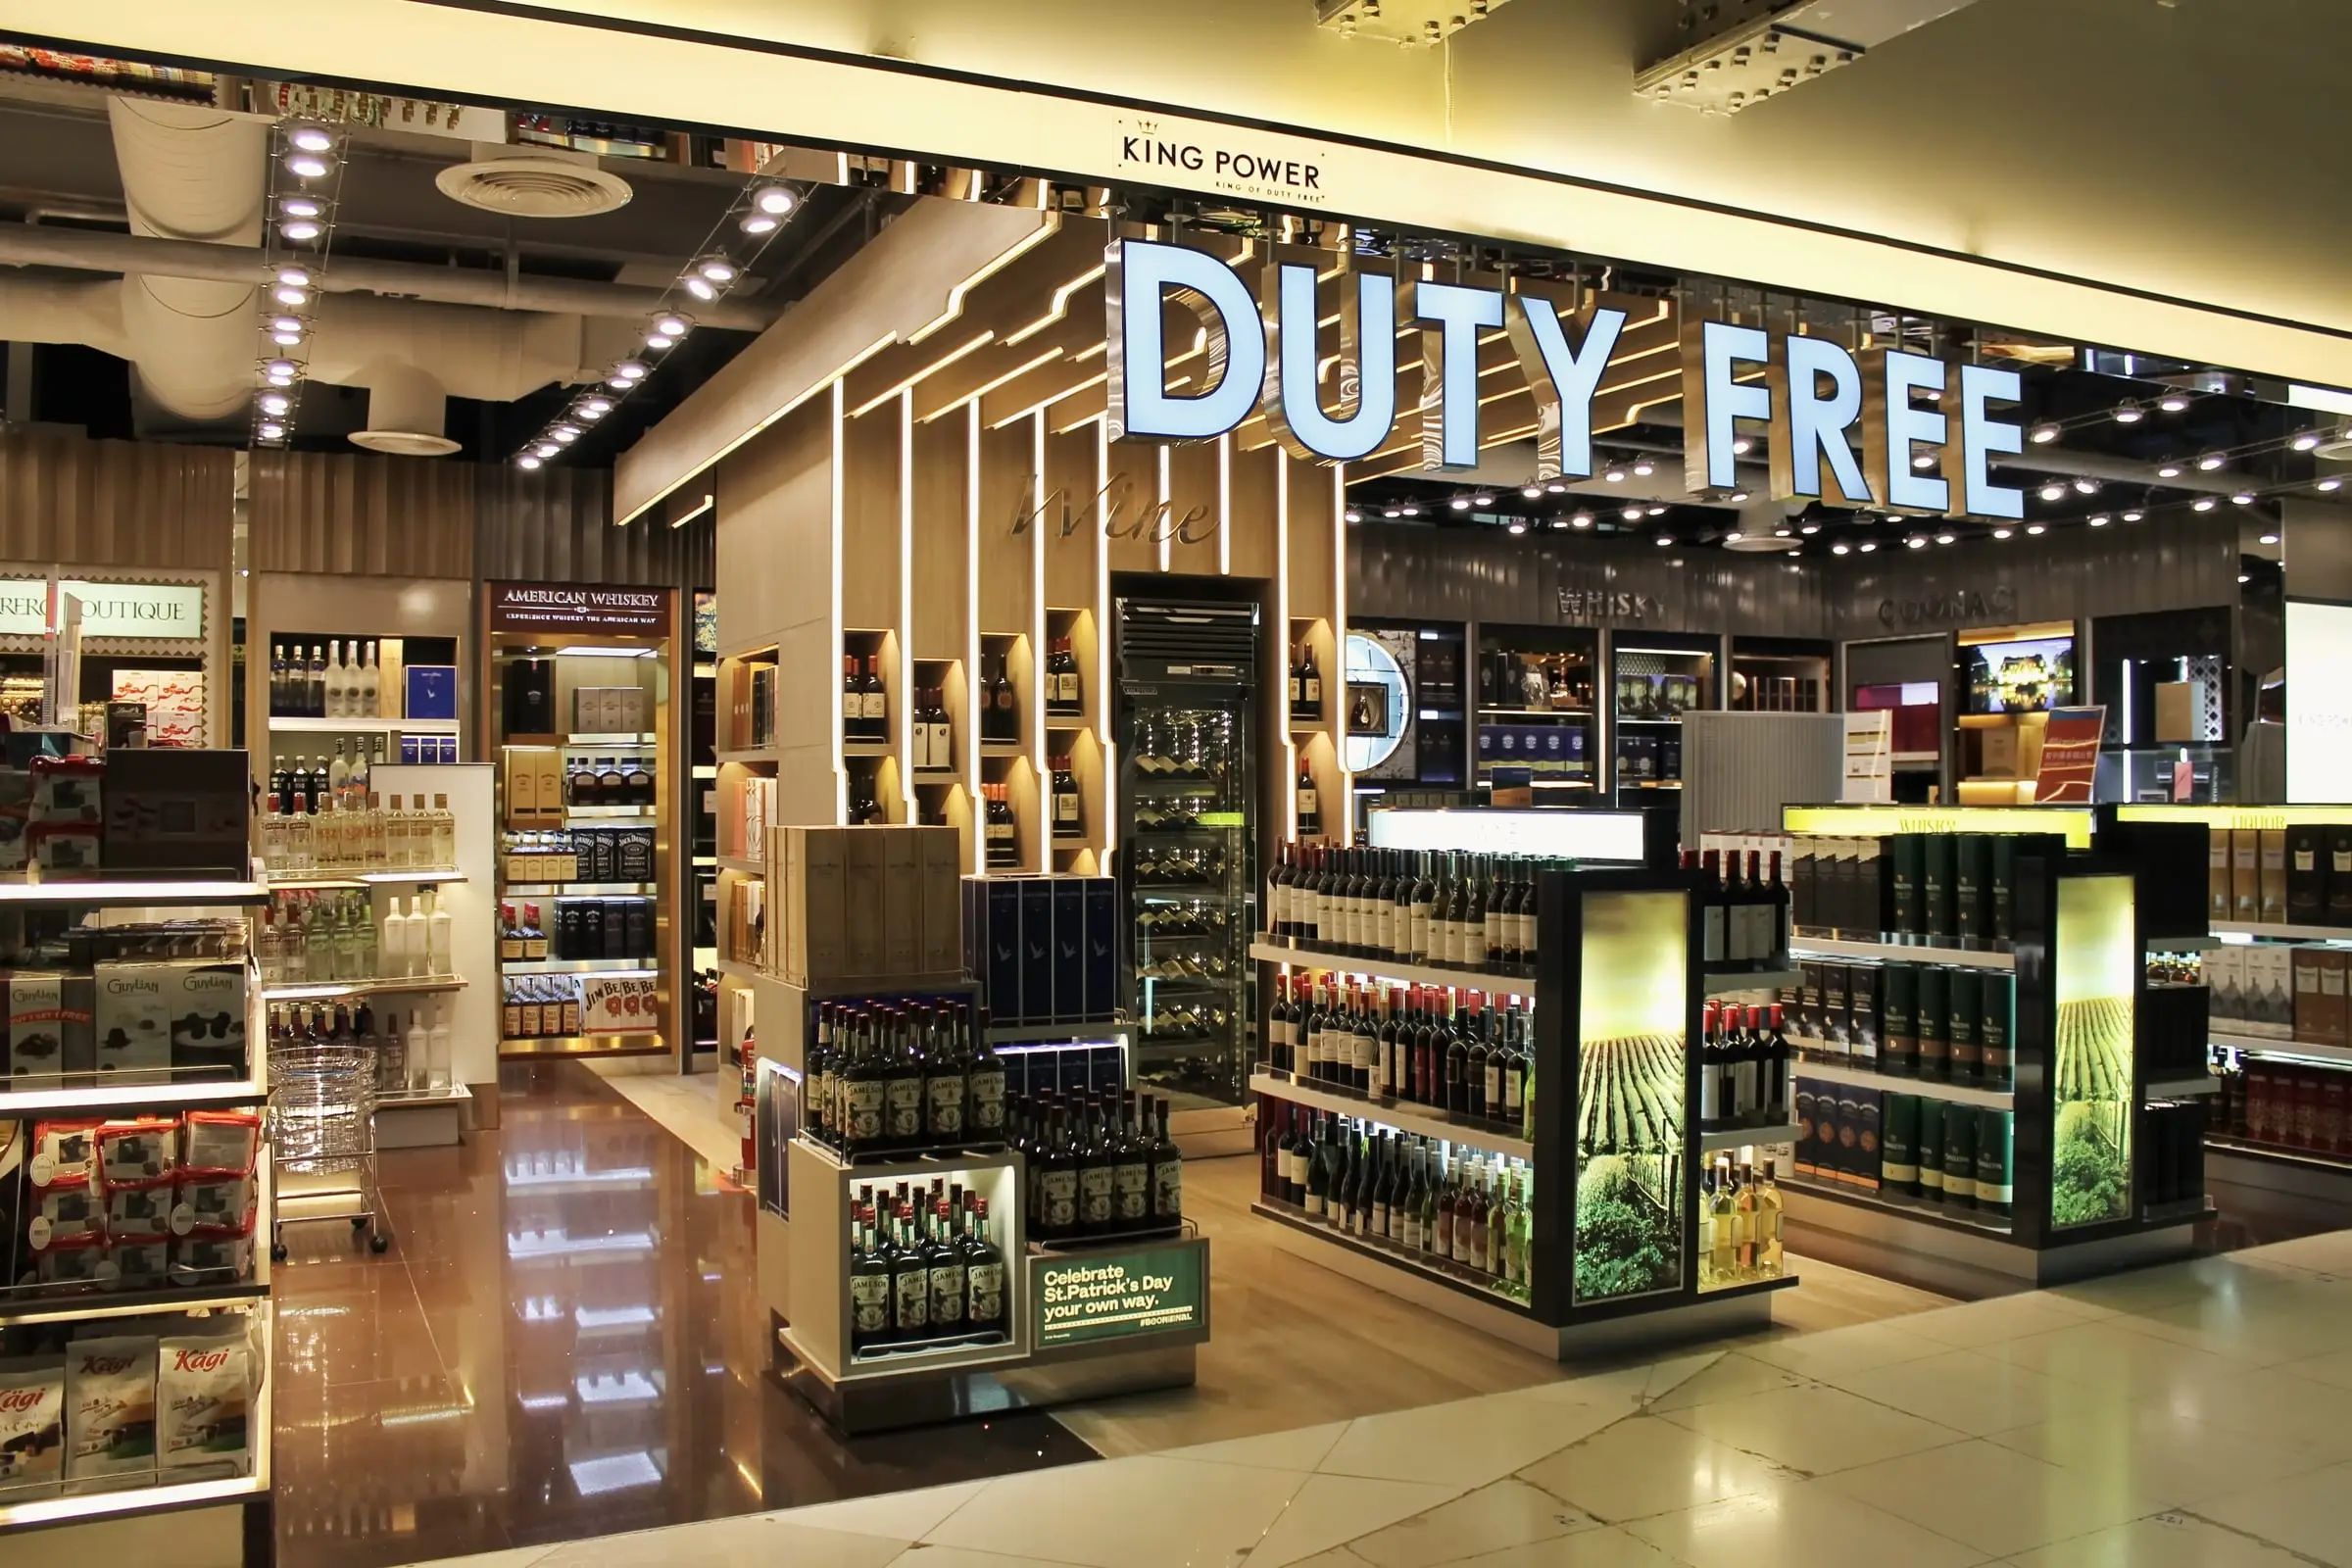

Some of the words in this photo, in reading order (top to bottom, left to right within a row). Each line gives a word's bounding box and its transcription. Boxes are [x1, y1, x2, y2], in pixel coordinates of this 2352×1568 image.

[1124, 136, 1203, 171] KING
[1216, 150, 1319, 189] POWER
[1215, 181, 1242, 191] KING
[1267, 189, 1291, 198] DUTY
[1115, 236, 1628, 478] DUTY
[1700, 318, 2026, 519] FREE
[1010, 471, 1221, 545] Wine
[504, 589, 587, 605] AMERICAN
[591, 592, 659, 607] WHISKEY
[1557, 586, 1666, 619] WHISKY
[81, 600, 185, 621] OUTIQUE
[640, 981, 656, 994] BE
[586, 988, 604, 1011] JIM
[1044, 1264, 1125, 1287] Celebrate
[1044, 1278, 1139, 1303] St.Patrick's
[1142, 1275, 1174, 1292] Day
[1044, 1302, 1082, 1323] your
[1085, 1298, 1119, 1314] own
[1122, 1294, 1159, 1311] way.
[79, 1353, 138, 1375] Kägi
[173, 1348, 230, 1372] Kägi
